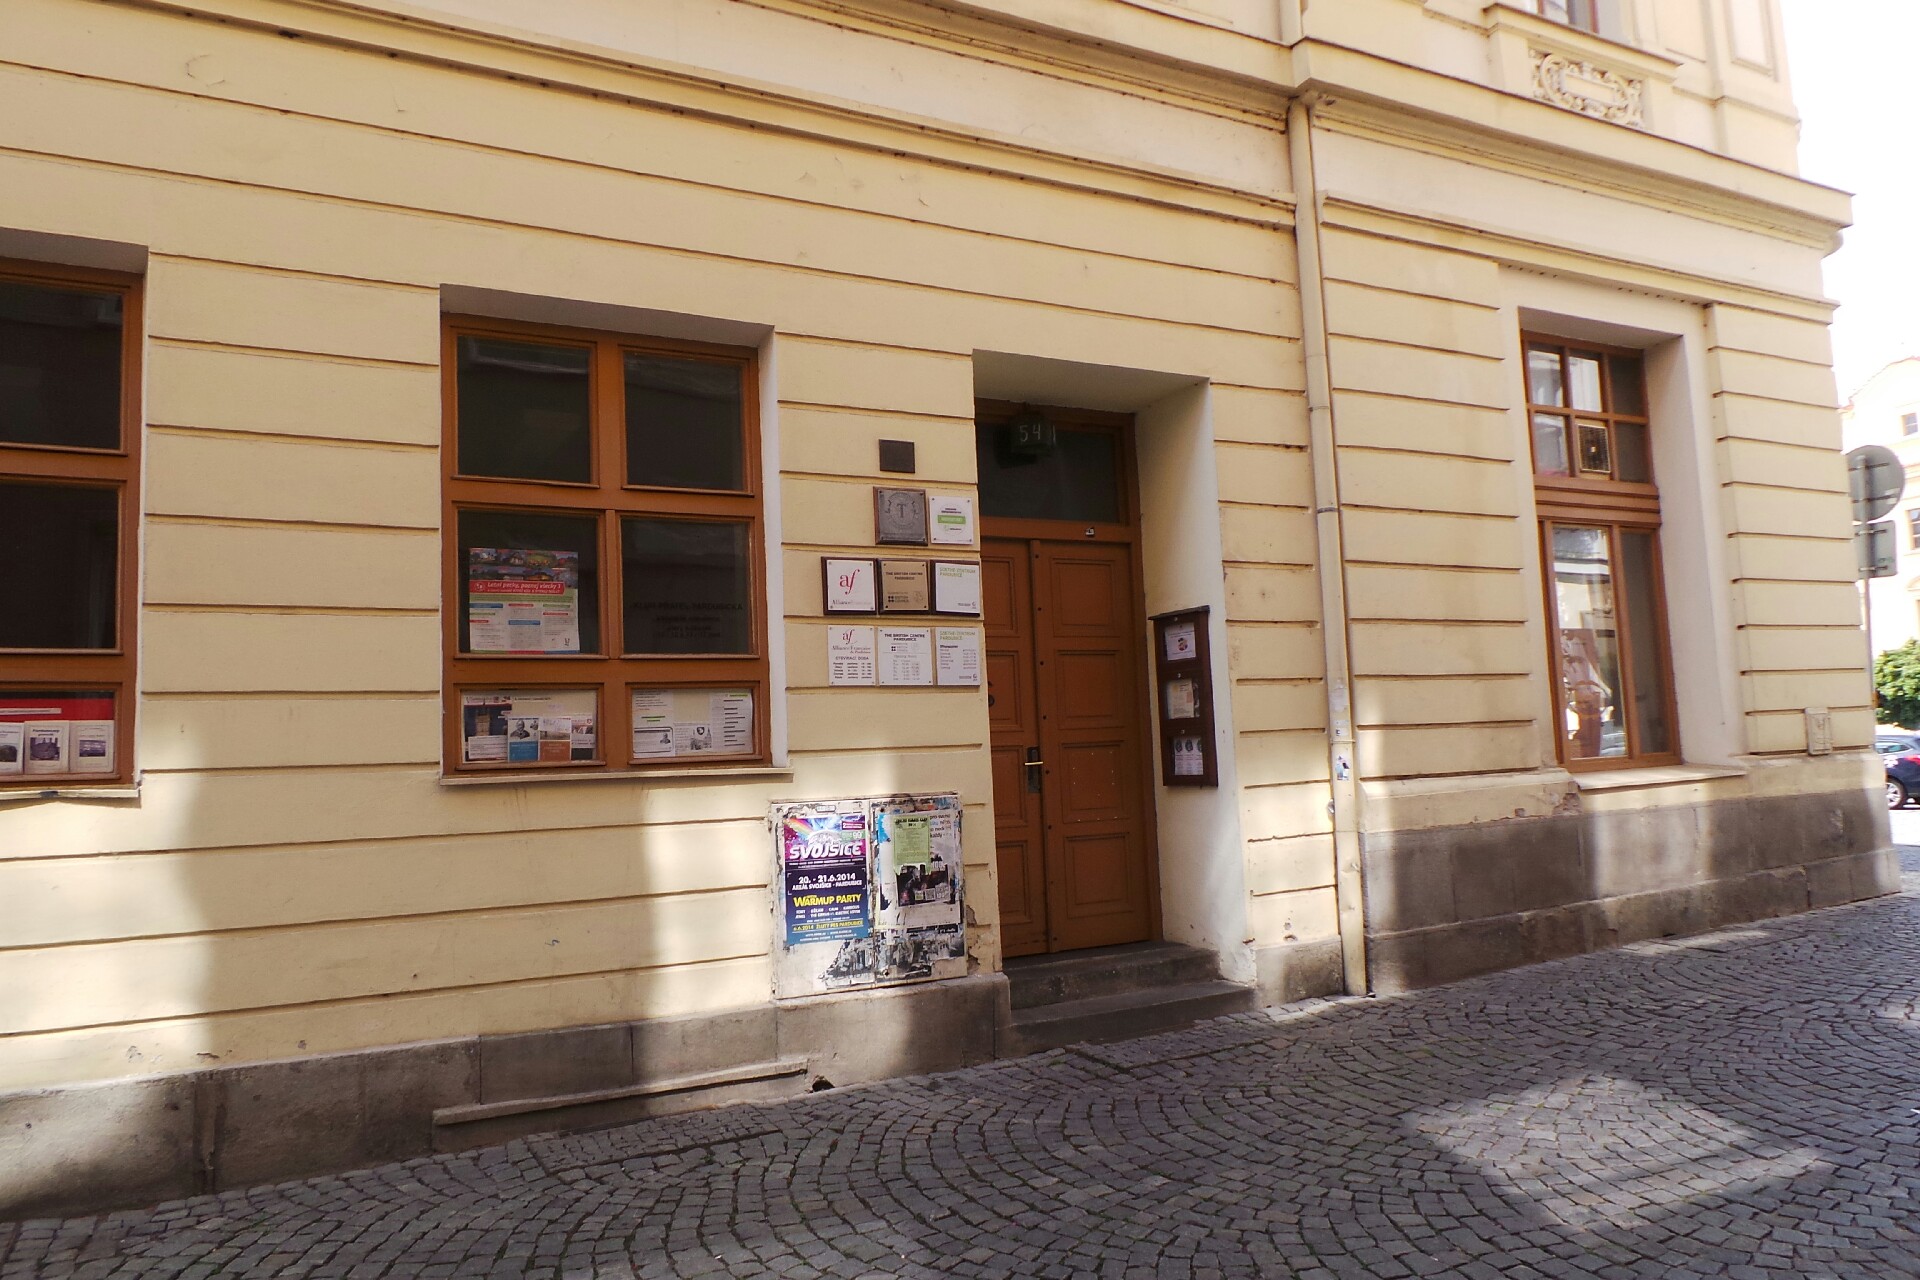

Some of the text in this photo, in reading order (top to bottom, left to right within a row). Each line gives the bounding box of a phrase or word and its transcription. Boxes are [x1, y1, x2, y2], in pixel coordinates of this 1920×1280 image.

[817, 872, 856, 883] 21.6.2014
[793, 893, 862, 908] WARMUP PARTY
